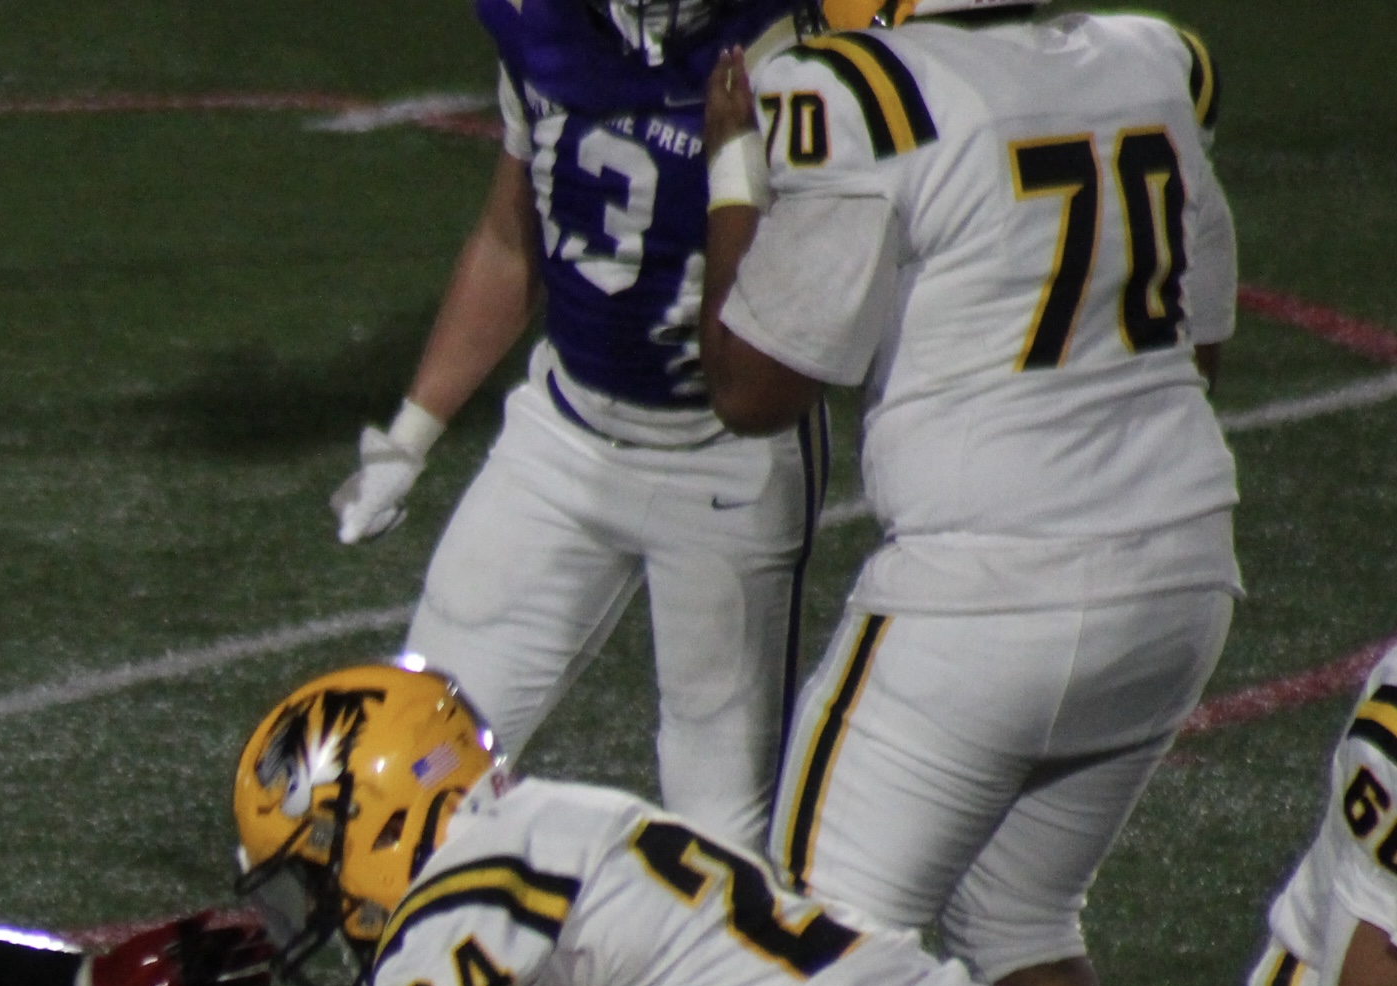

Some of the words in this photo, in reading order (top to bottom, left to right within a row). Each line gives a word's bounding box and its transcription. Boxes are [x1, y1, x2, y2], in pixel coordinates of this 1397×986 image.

[645, 117, 703, 160] PREP
[757, 90, 830, 169] 70
[1008, 124, 1187, 373] 70
